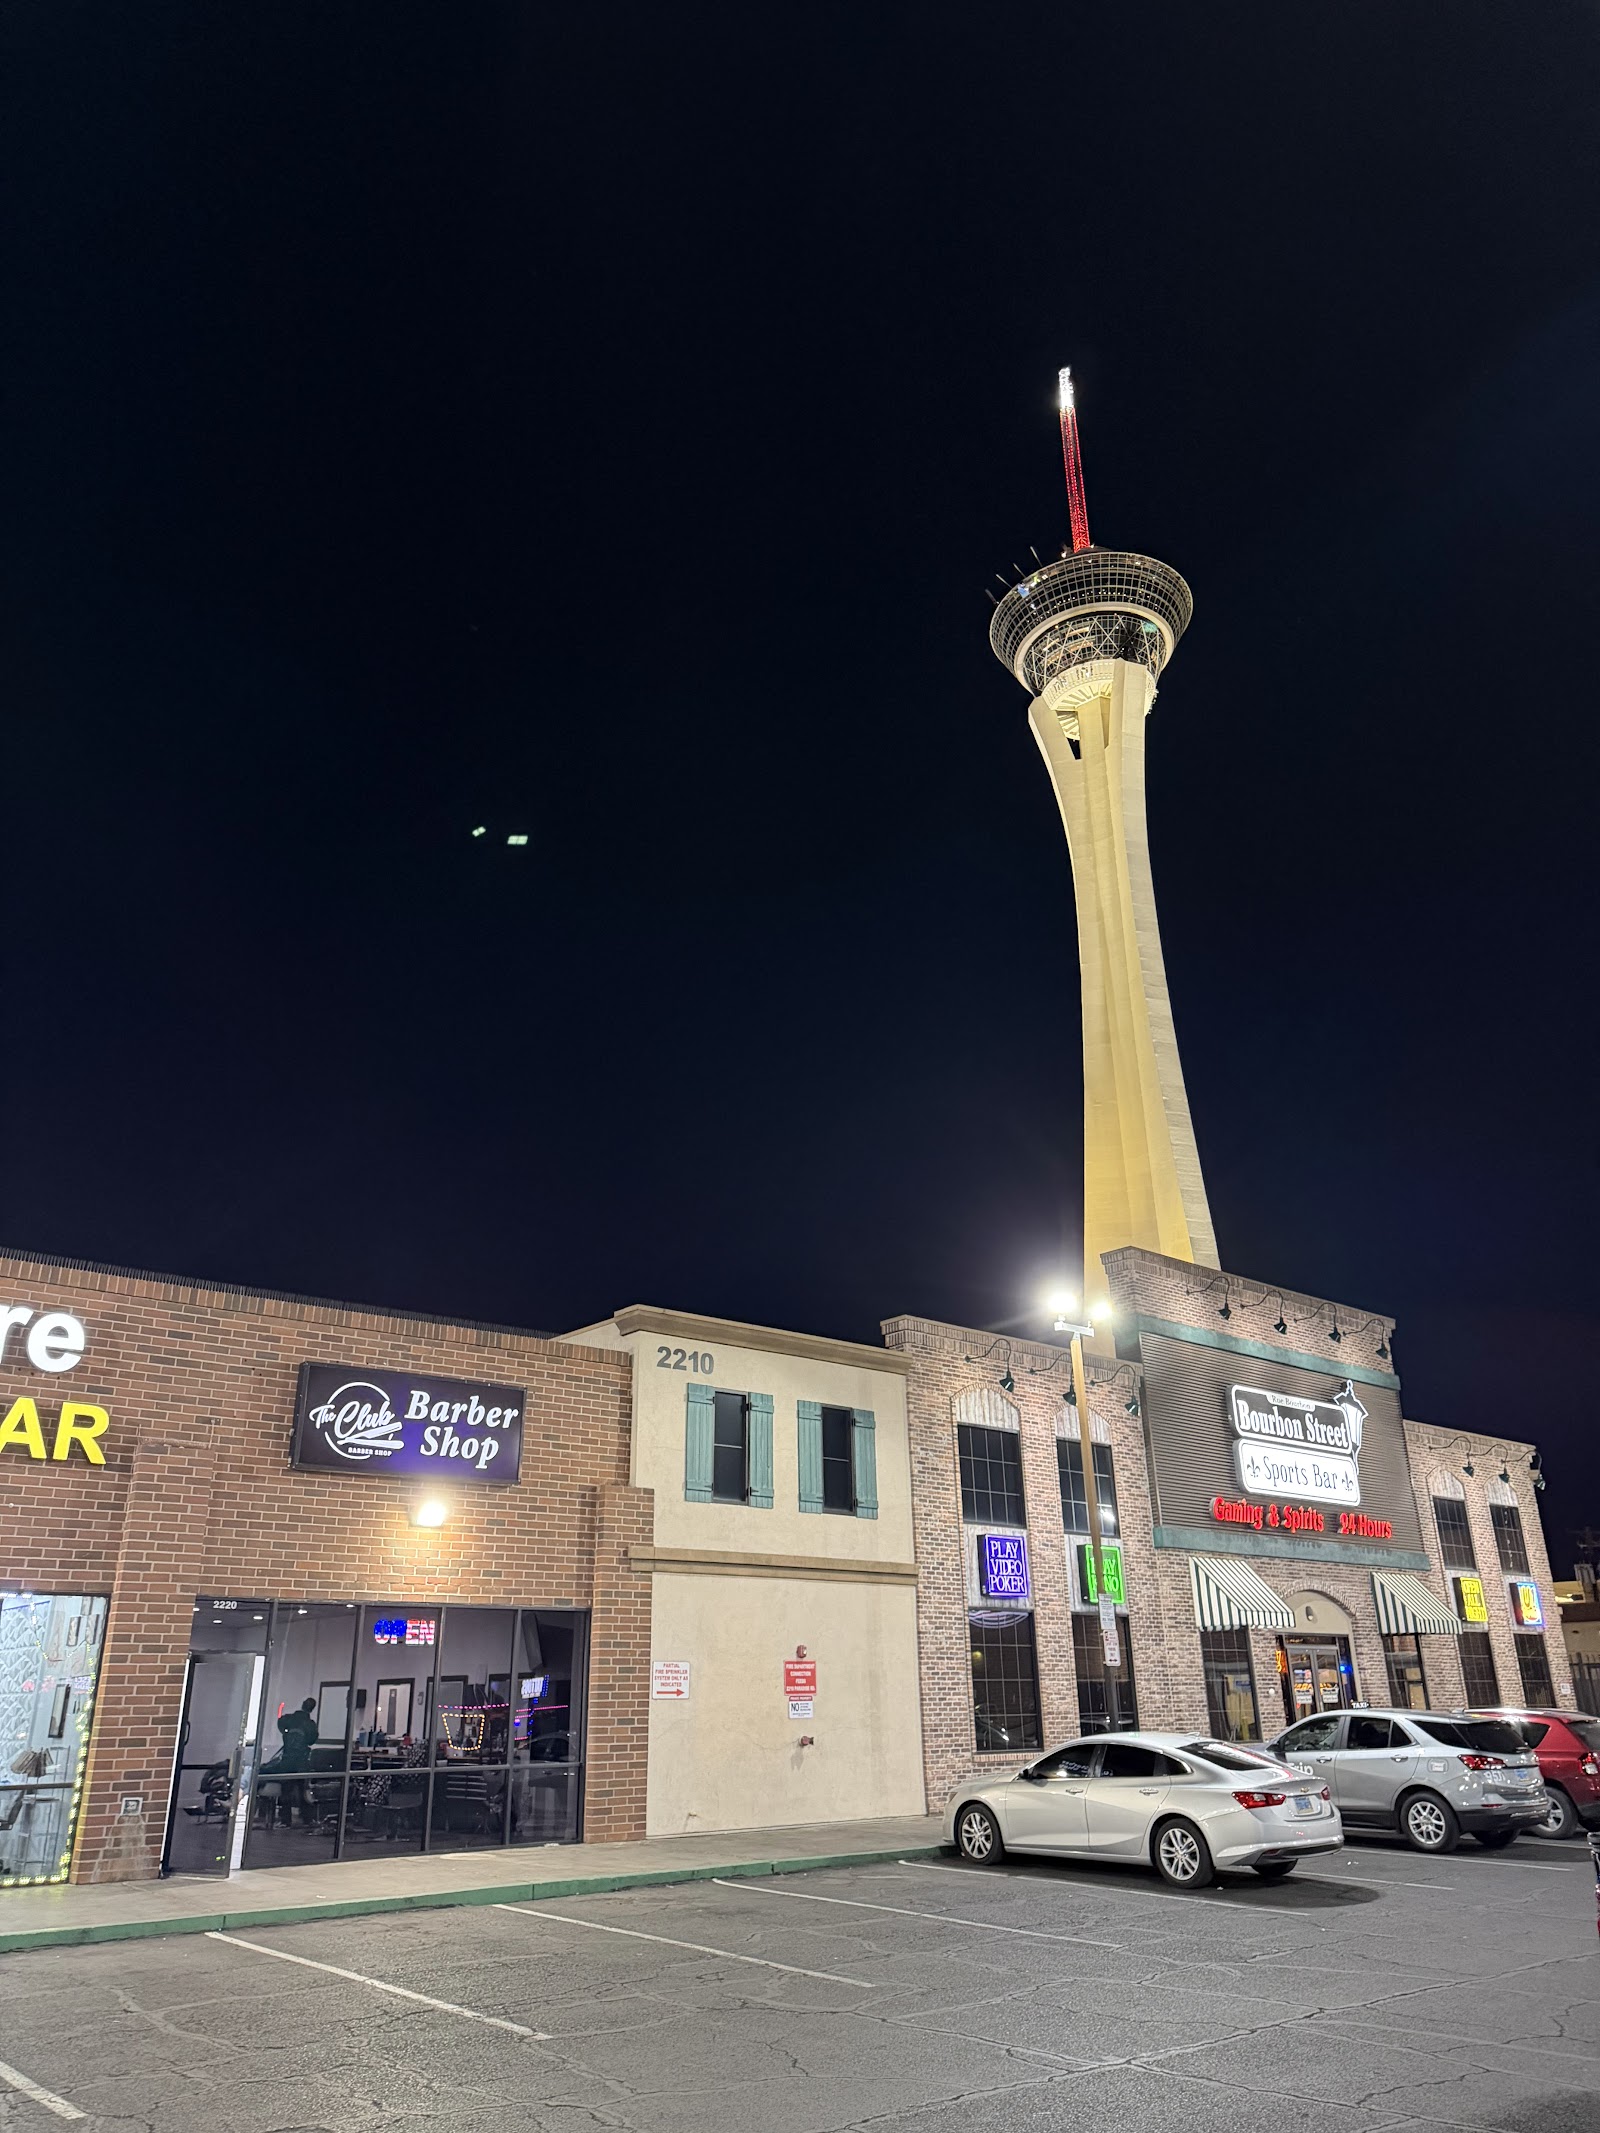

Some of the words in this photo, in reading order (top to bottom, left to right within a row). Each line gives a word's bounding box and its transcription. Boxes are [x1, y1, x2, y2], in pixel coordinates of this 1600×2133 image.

[657, 1346, 714, 1374] 2210
[309, 1404, 336, 1429] The
[334, 1401, 395, 1438] Club
[404, 1390, 519, 1428] Barber
[0, 1397, 109, 1465] AR
[1237, 1399, 1304, 1440] Bourbon
[1304, 1413, 1348, 1448] Street
[348, 1447, 373, 1455] BARBER
[374, 1449, 392, 1457] SHOP
[420, 1426, 499, 1469] Shop
[1263, 1456, 1308, 1487] Sports
[1312, 1463, 1338, 1490] Bar
[1213, 1495, 1263, 1530] Gaming
[1268, 1503, 1279, 1527] &
[1282, 1505, 1324, 1533] Spirits
[1339, 1512, 1356, 1535] 24
[1357, 1514, 1392, 1539] Hours
[990, 1540, 1018, 1559] PLAY
[991, 1558, 1022, 1577] VIDEO
[990, 1576, 1025, 1593] POKER
[1463, 1580, 1480, 1593] OPEN
[213, 1600, 237, 1610] 2220
[1466, 1593, 1482, 1607] ALL
[374, 1619, 435, 1644] OPEN
[791, 1703, 799, 1711] NO
